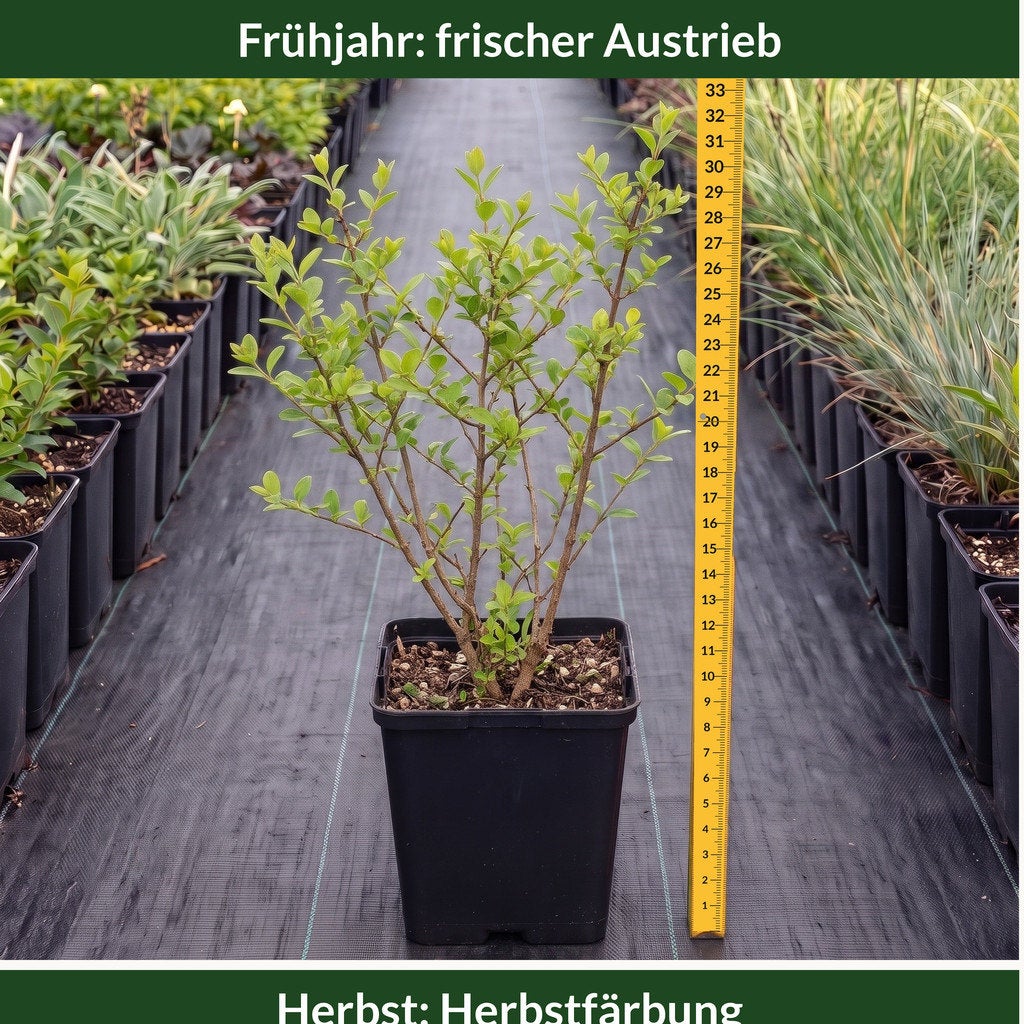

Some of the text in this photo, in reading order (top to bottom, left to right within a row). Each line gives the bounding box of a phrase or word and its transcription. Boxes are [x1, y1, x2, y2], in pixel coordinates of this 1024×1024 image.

[706, 83, 726, 97] 33
[706, 108, 725, 123] 32
[705, 134, 725, 148] 31
[705, 160, 724, 174] 30
[705, 185, 724, 199] 29
[704, 211, 723, 224] 28
[704, 236, 723, 250] 27
[704, 262, 722, 275] 26
[704, 287, 721, 300] 25
[704, 313, 722, 326] 24
[703, 338, 721, 351] 23
[703, 364, 720, 377] 22
[703, 390, 719, 402] 21
[703, 415, 719, 427] 20
[703, 441, 719, 453] 19
[703, 466, 718, 478] 18
[703, 492, 718, 504] 17
[703, 518, 718, 529] 16
[703, 543, 717, 554] 15
[702, 569, 717, 580] 14
[702, 594, 716, 605] 13
[702, 620, 715, 631] 12
[702, 645, 716, 656] 11
[702, 671, 715, 681] 10
[704, 697, 711, 707] 9
[703, 722, 710, 732] 8
[704, 747, 710, 757] 7
[703, 773, 709, 783] 6
[703, 798, 709, 808] 5
[703, 824, 709, 833] 4
[702, 850, 709, 859] 3
[702, 875, 708, 884] 2
[702, 901, 708, 910] 1
